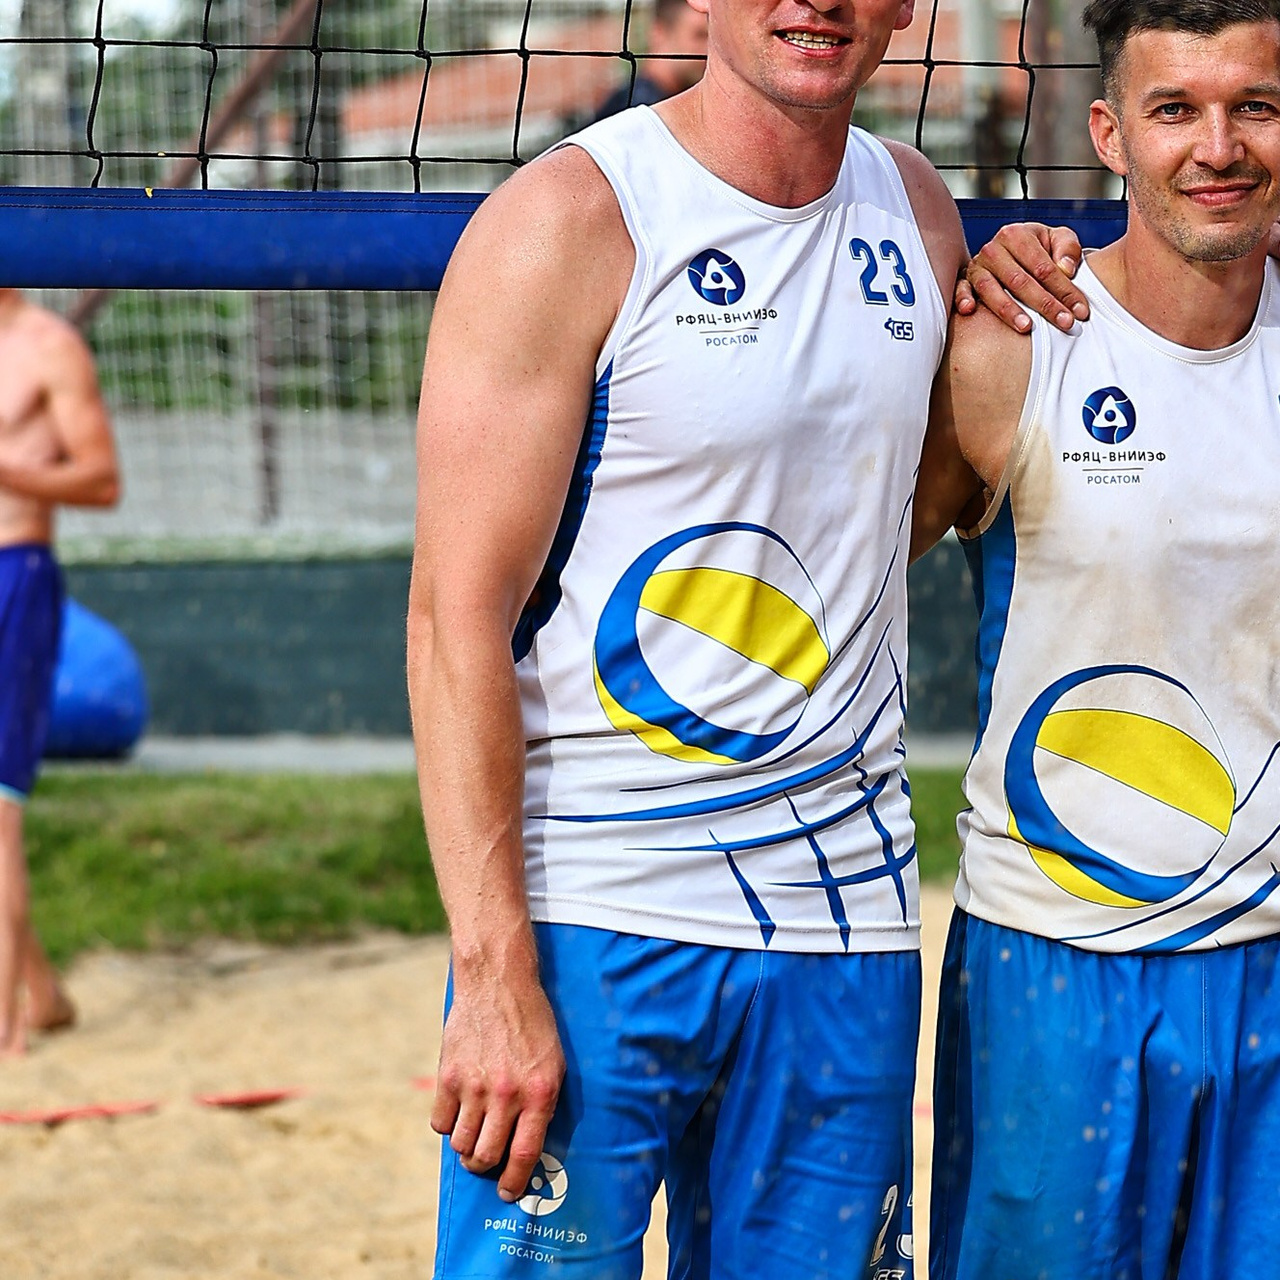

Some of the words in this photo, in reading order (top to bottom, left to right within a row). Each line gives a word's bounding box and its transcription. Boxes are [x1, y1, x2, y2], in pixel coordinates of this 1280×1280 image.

[849, 237, 916, 307] 23
[676, 308, 778, 326] РФЯЦ-ВНИИЭФ
[705, 334, 759, 347] РОСАТОМ
[1062, 451, 1167, 464] РФЯЦ-ВНИИЭФ
[1087, 474, 1141, 485] РОСАТОМ
[484, 1218, 588, 1244] РФЯЦ-ВНИИЭФ
[499, 1244, 554, 1264] РОСАТОМ
